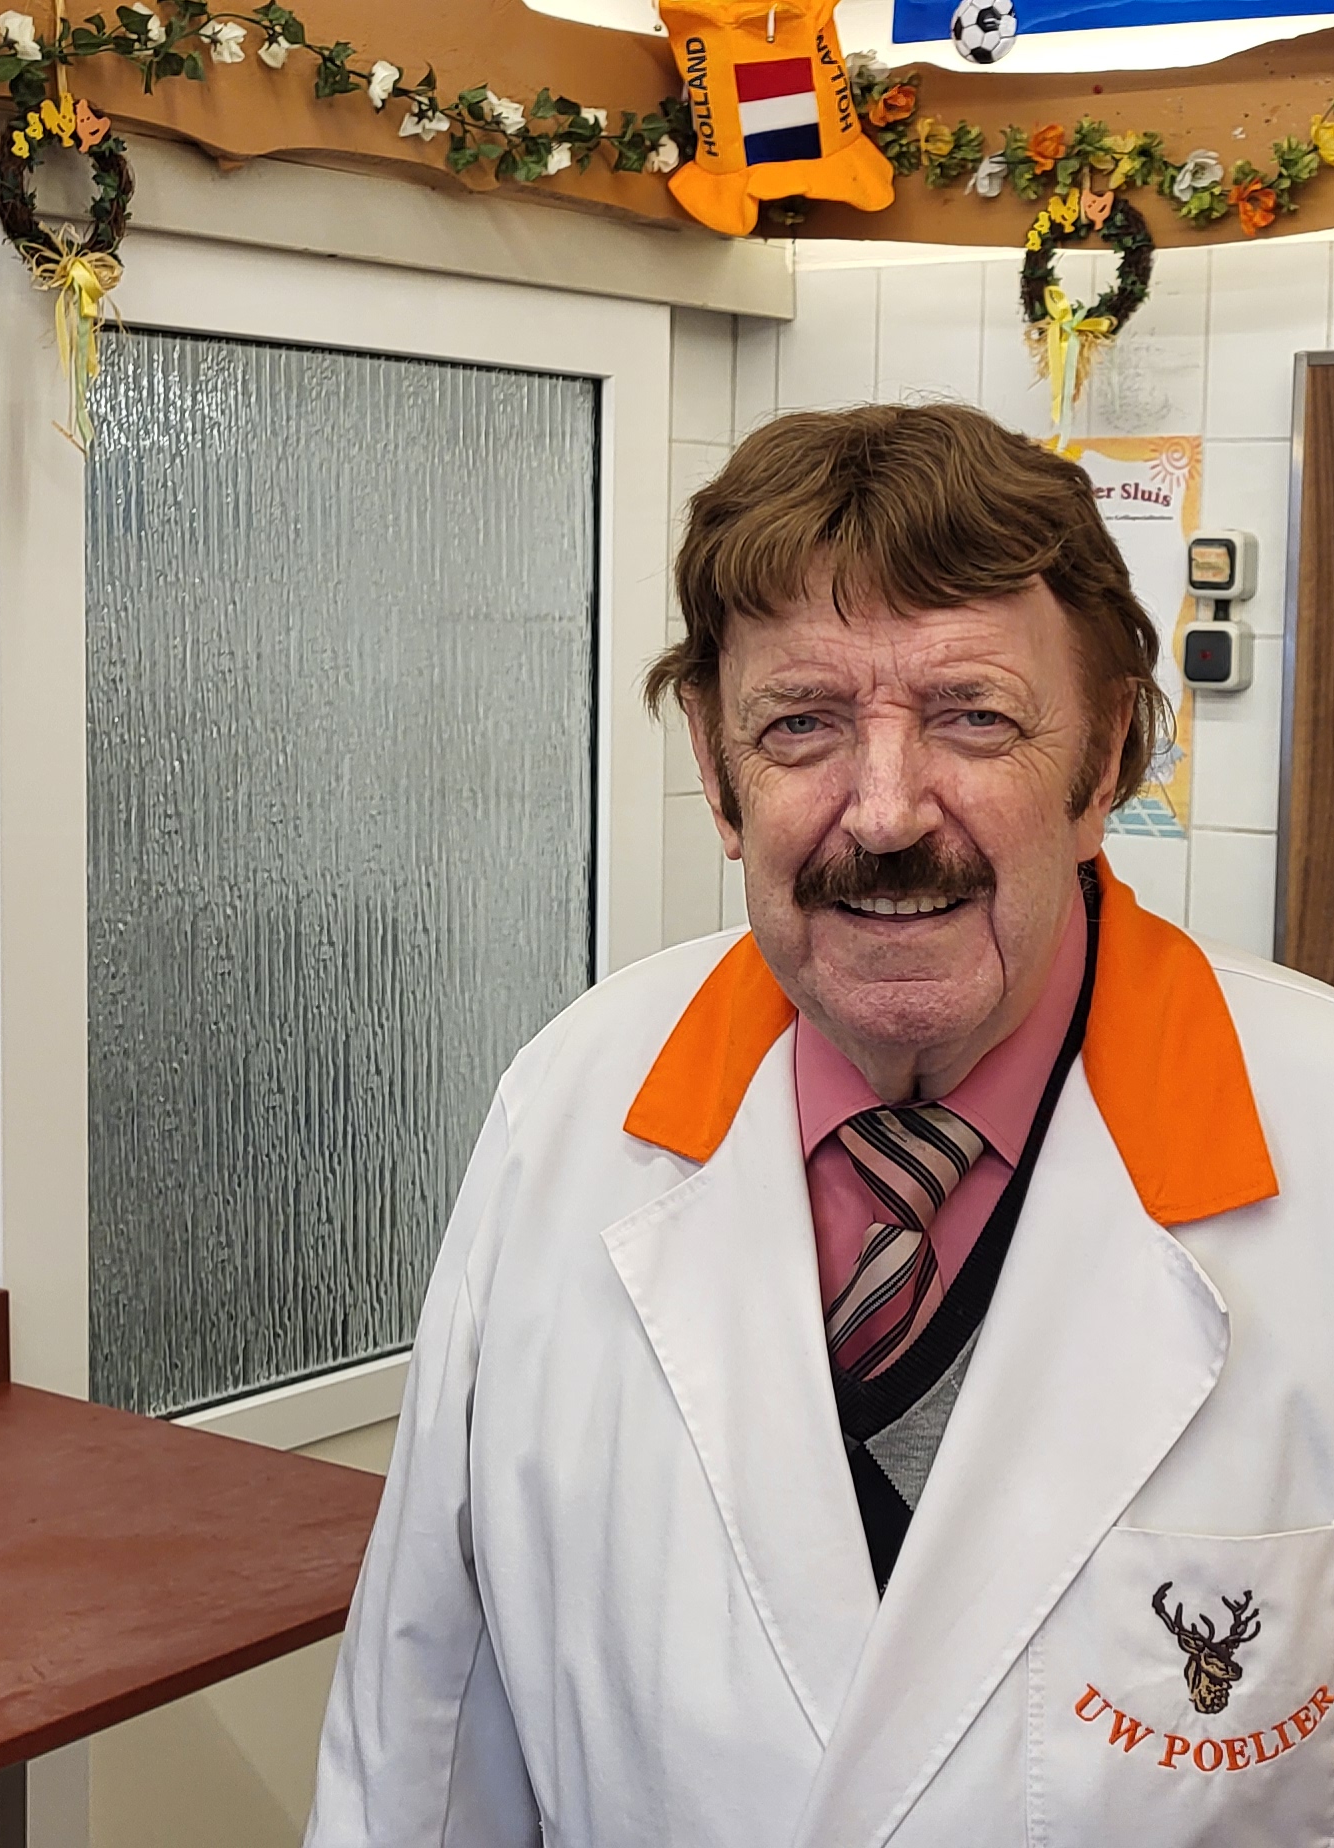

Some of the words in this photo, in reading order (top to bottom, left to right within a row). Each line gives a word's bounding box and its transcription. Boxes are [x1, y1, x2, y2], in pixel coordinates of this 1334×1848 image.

[685, 36, 720, 157] HOLLAND
[815, 26, 854, 133] HOLLAN
[1120, 482, 1173, 507] Sluis
[1074, 1682, 1156, 1754] UW
